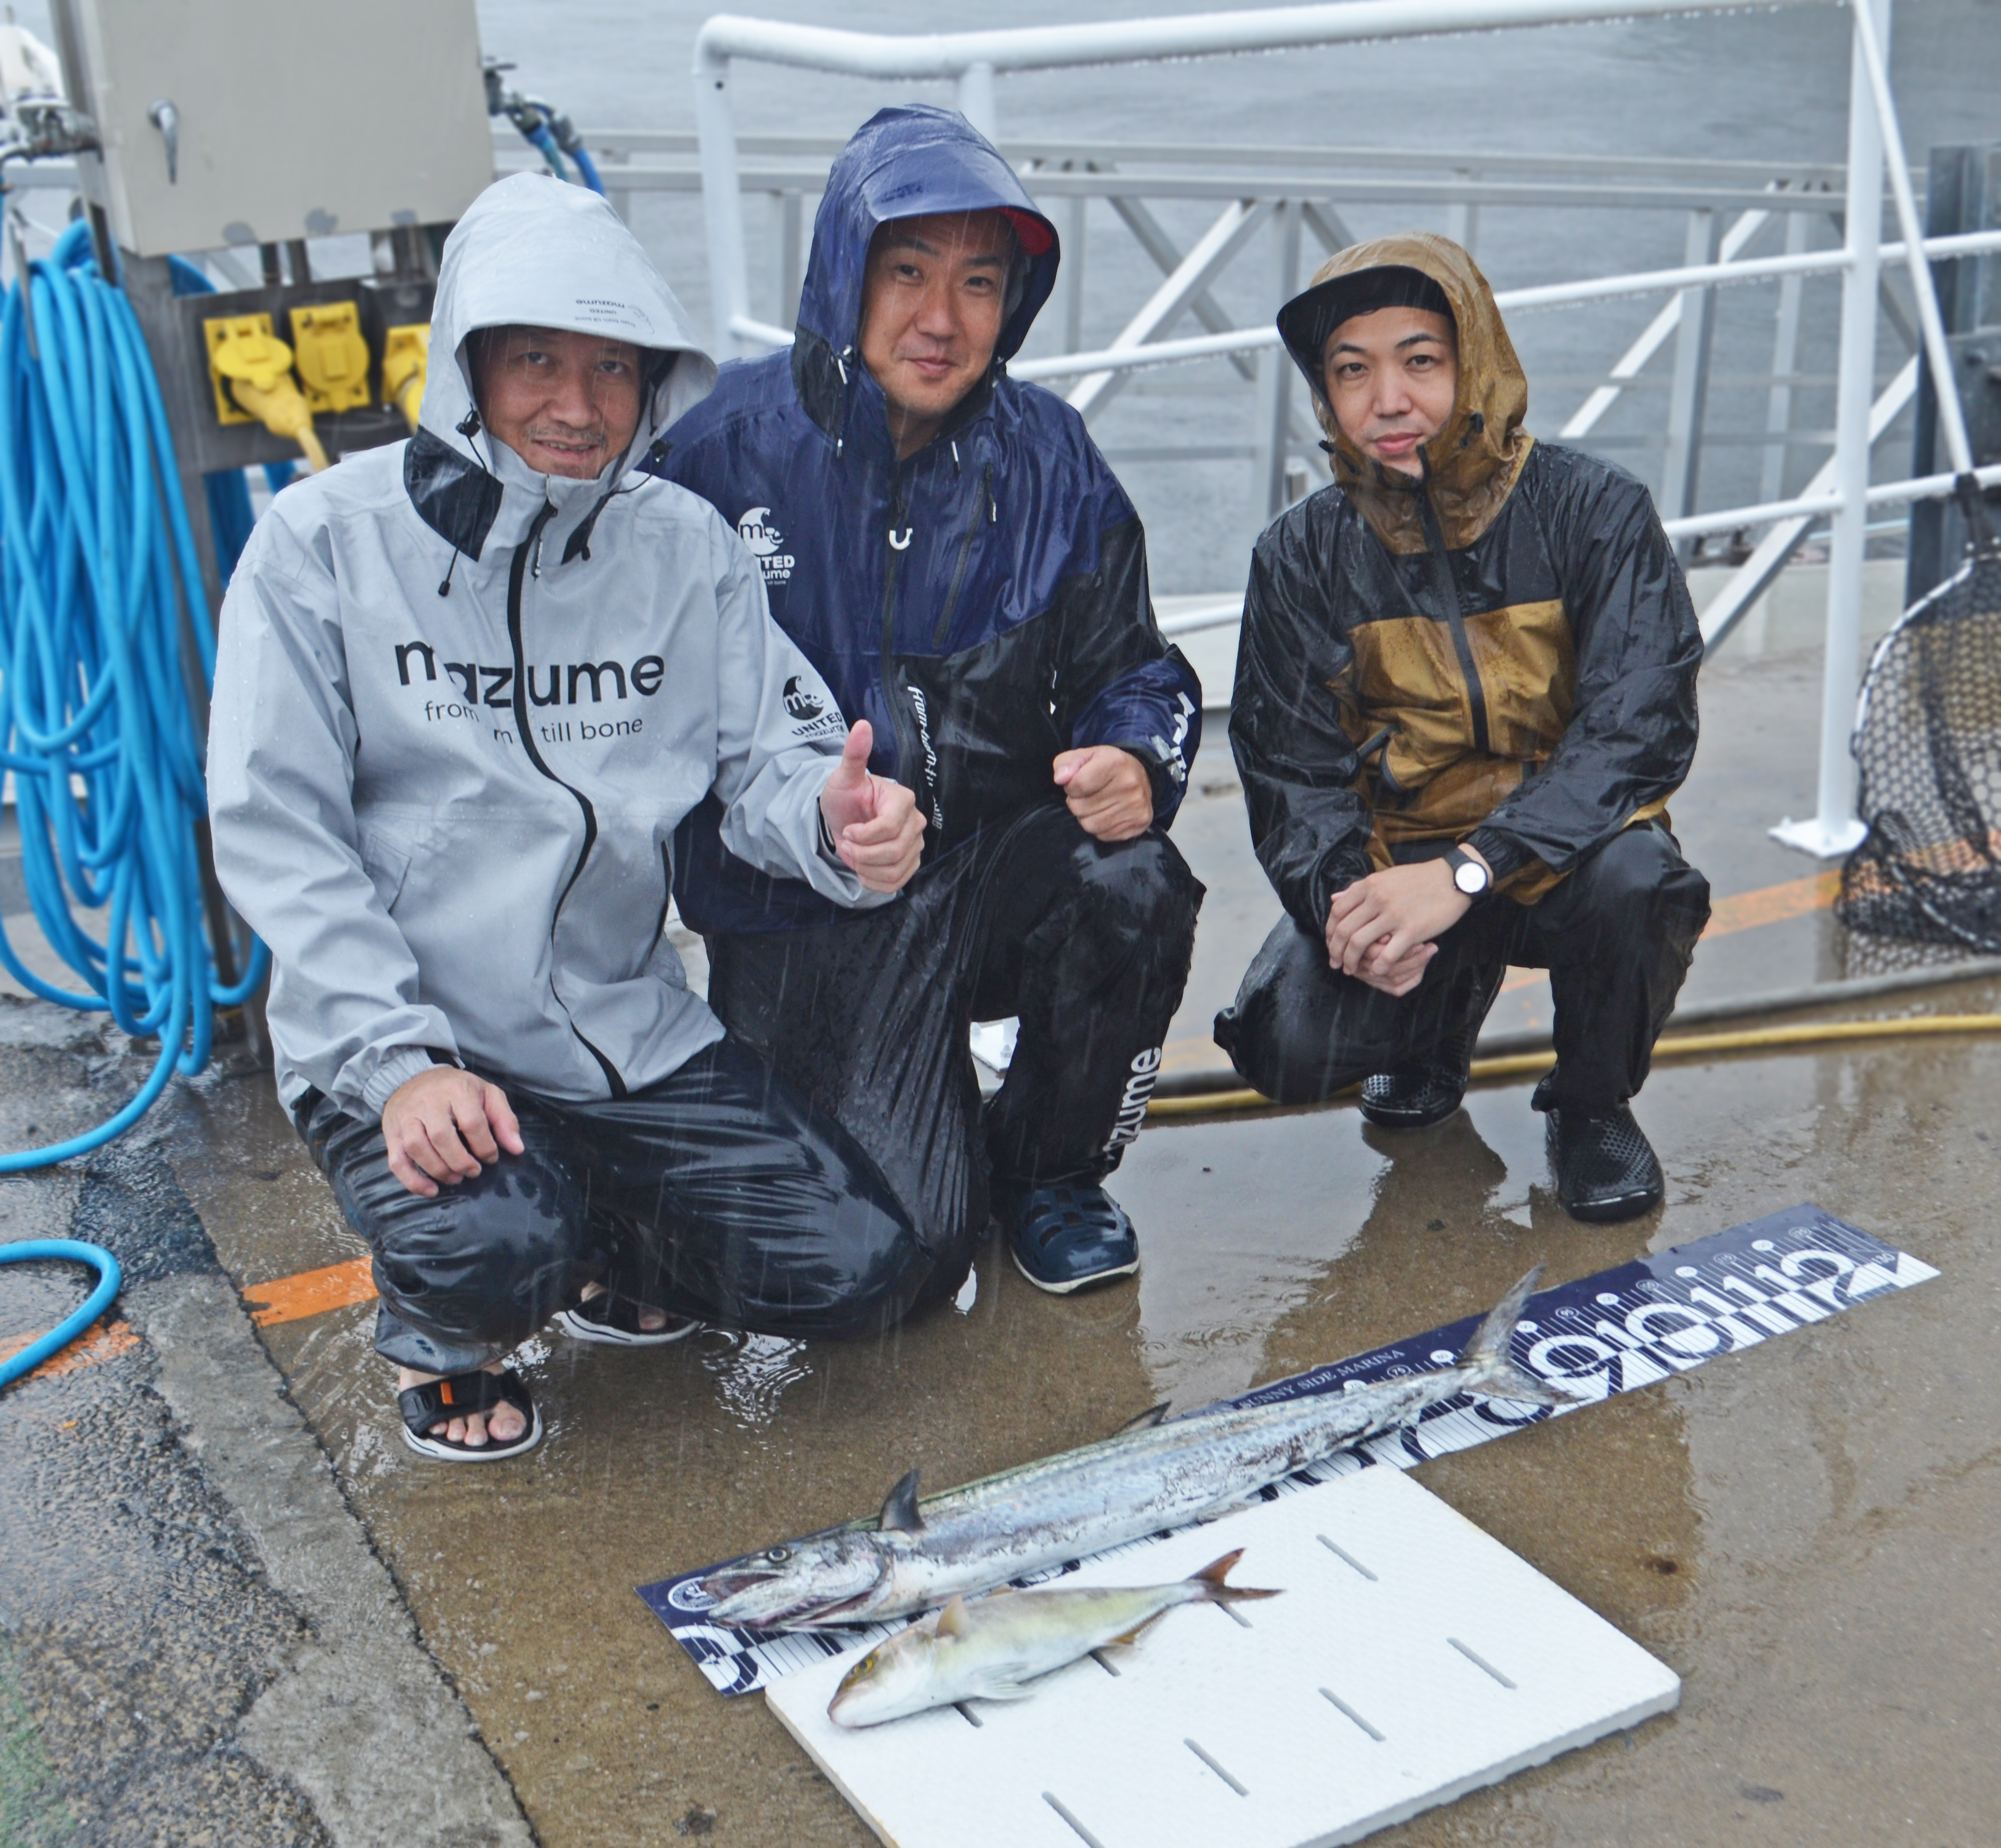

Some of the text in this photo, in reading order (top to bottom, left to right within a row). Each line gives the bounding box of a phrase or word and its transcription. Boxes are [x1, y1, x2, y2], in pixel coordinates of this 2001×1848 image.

[575, 299, 625, 309] mazume
[424, 700, 479, 722] from
[541, 722, 571, 742] till
[580, 718, 643, 740] bone
[792, 711, 843, 736] UNITED
[1239, 1385, 1296, 1409] SUNNY
[1297, 1370, 1337, 1390] SIDE
[1337, 1349, 1406, 1377] MARINA
